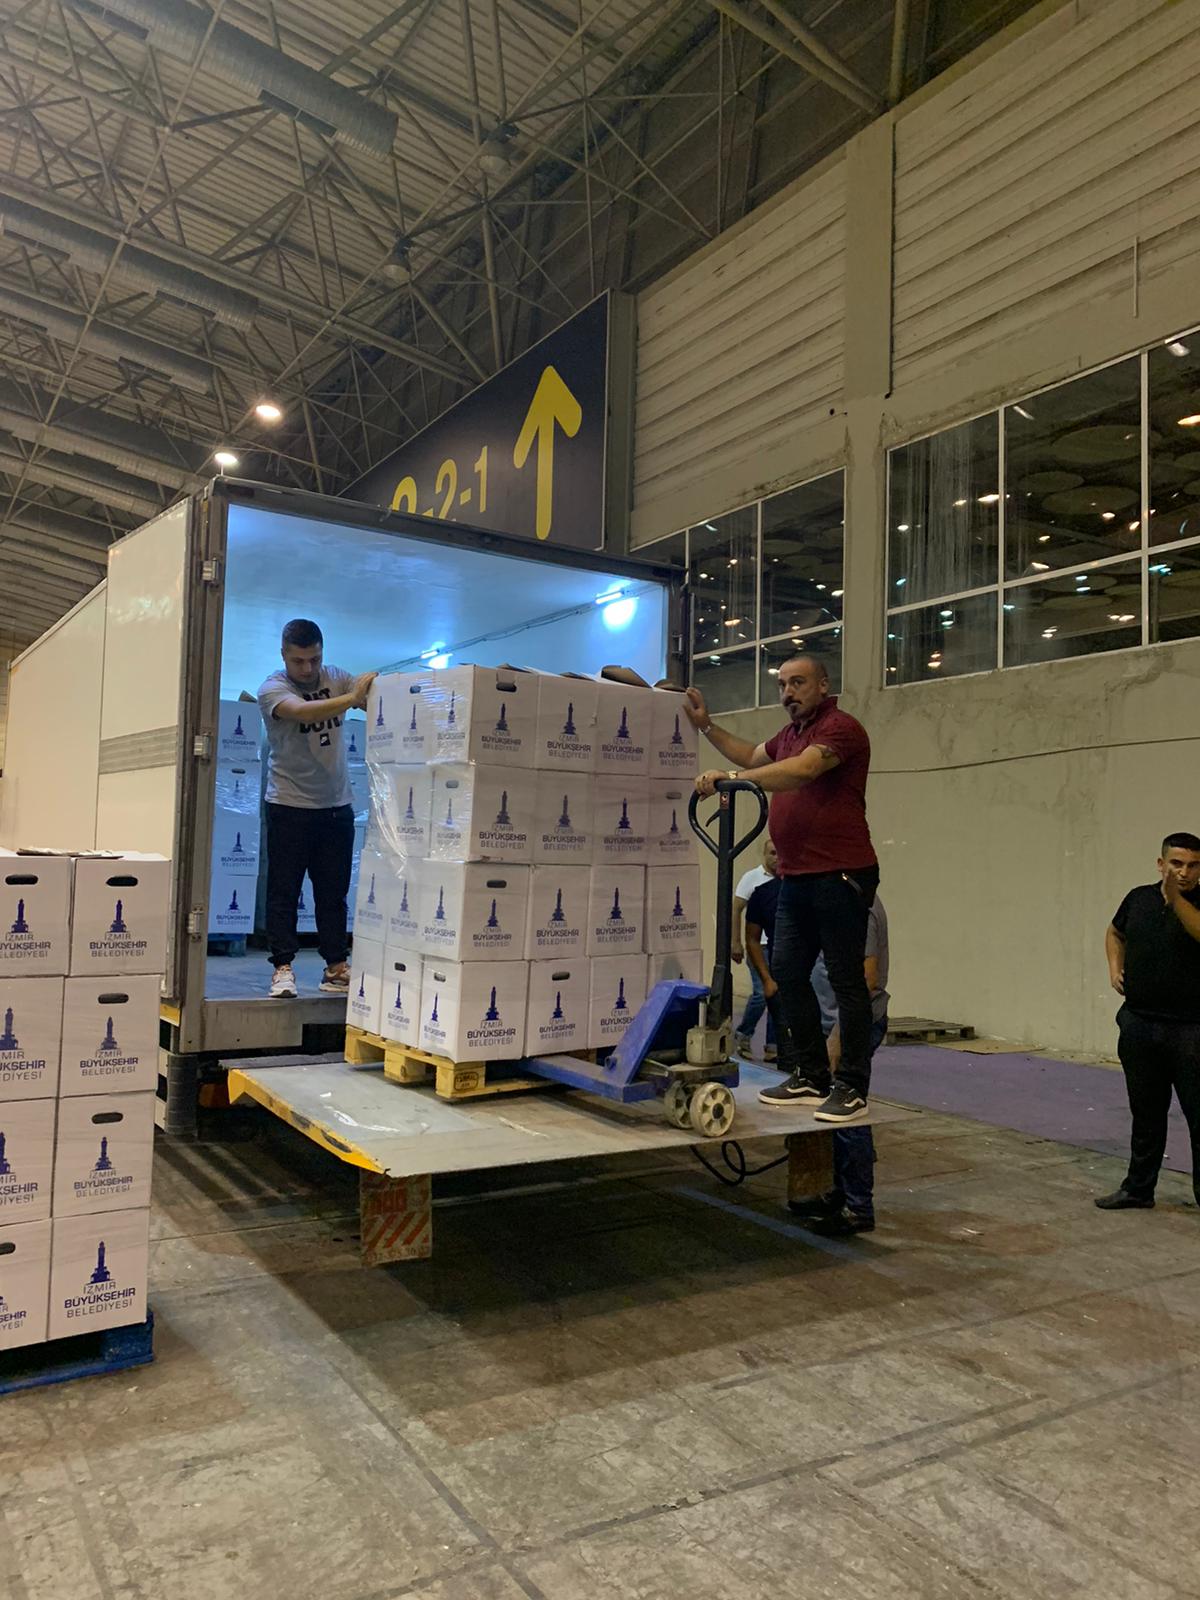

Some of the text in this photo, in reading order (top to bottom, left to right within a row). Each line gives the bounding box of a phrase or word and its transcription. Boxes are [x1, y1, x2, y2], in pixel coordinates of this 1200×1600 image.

[0, 941, 51, 950] YÜKŞEHİR
[0, 950, 49, 959] ELEDİYESİ
[1, 1050, 25, 1060] MİR
[0, 1060, 46, 1072] KŞEHİR
[0, 1071, 42, 1082] DİYESİ
[83, 1281, 117, 1295] İZMİR
